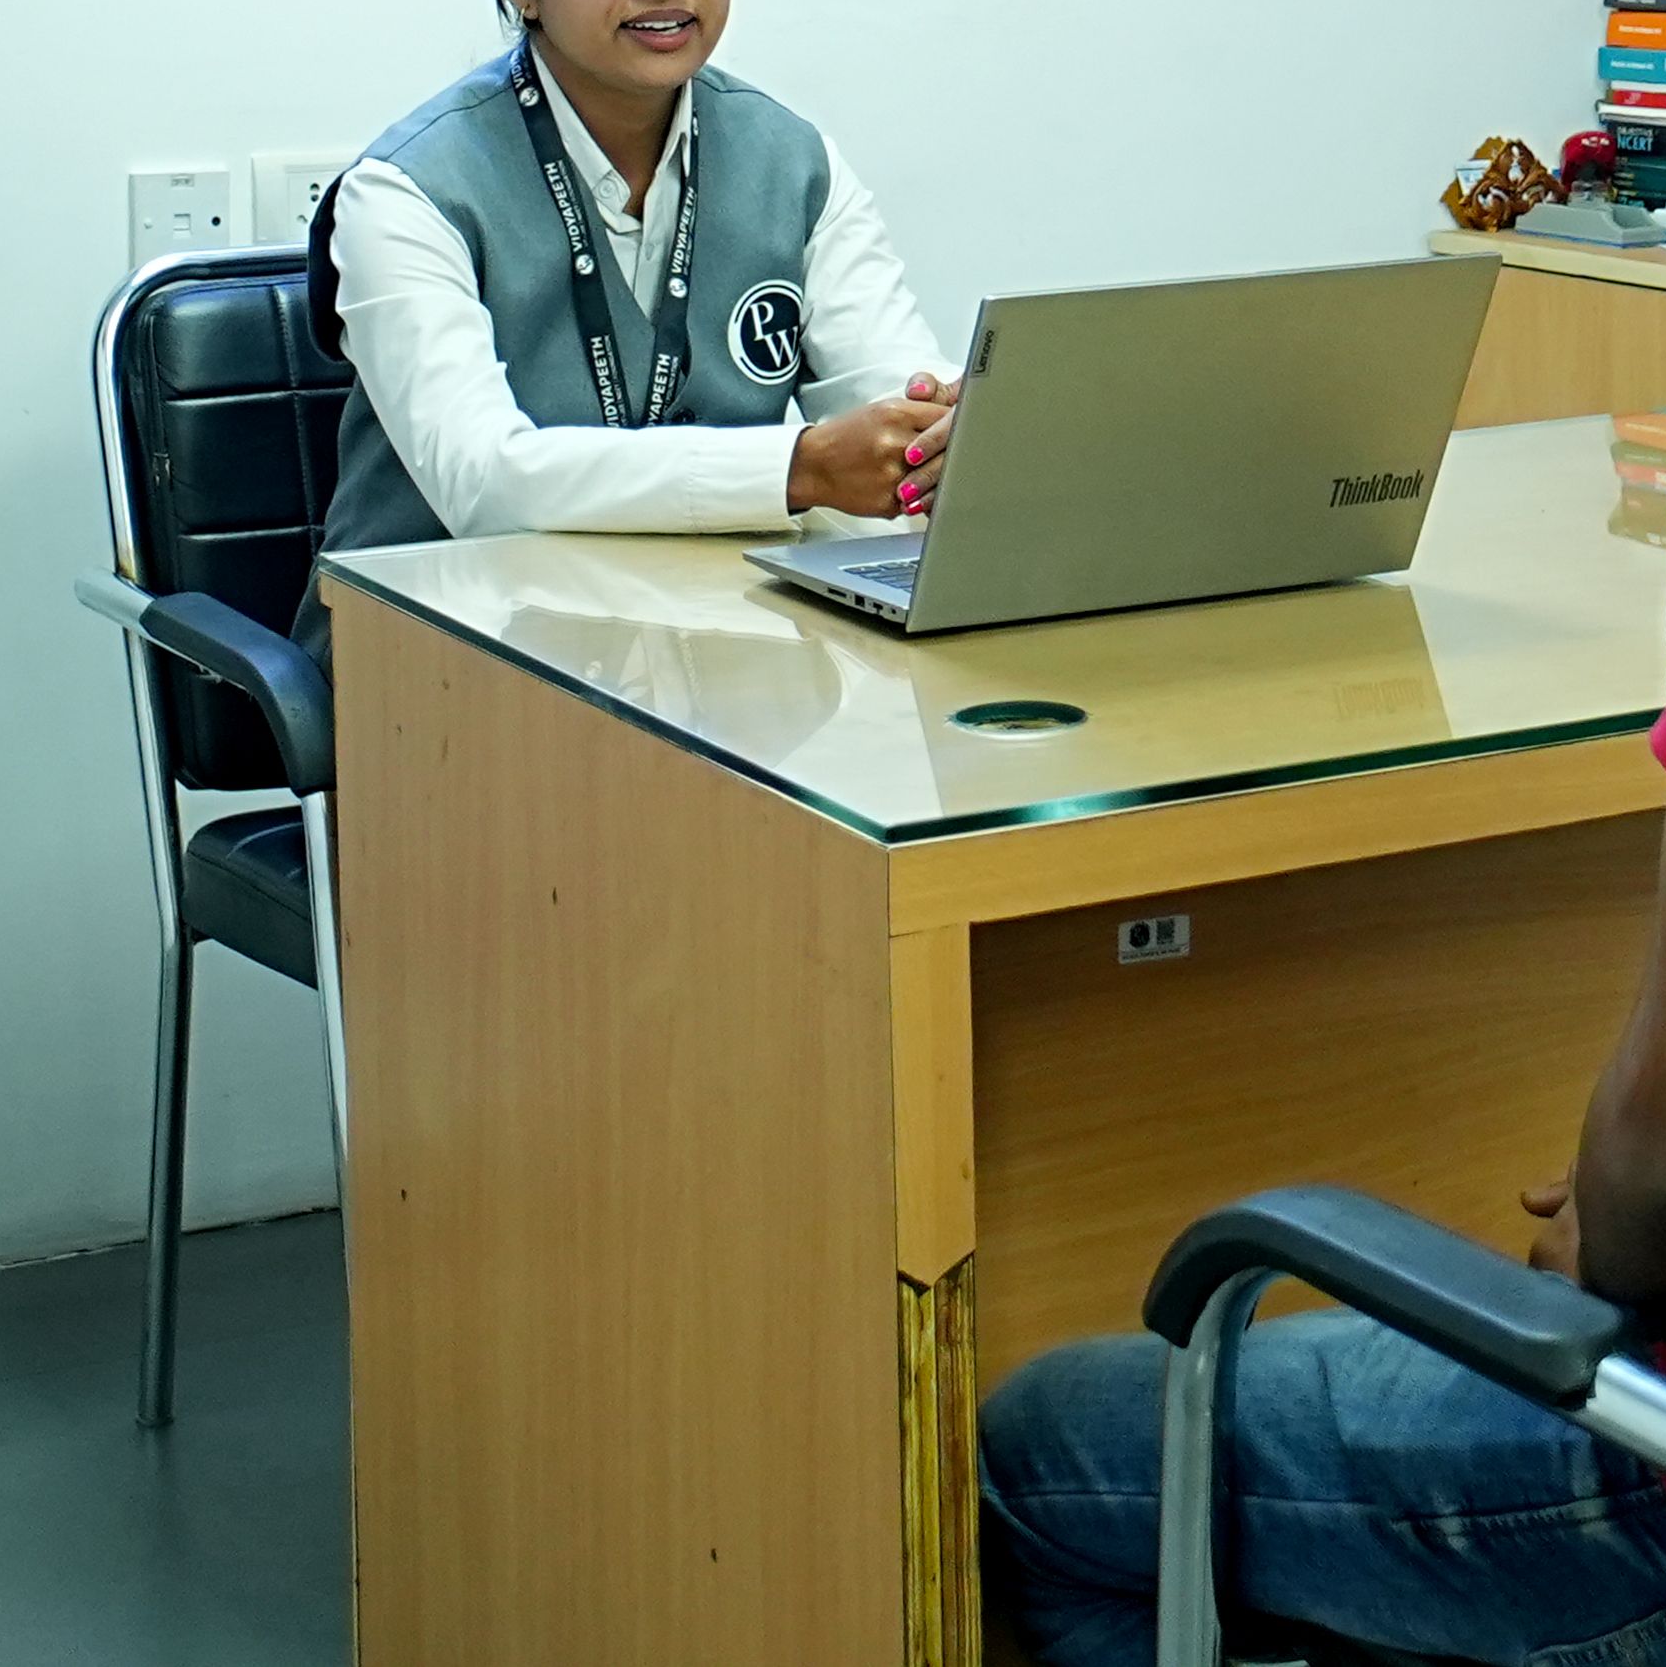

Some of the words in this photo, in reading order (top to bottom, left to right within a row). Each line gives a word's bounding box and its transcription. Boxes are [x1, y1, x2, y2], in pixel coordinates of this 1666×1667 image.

[1617, 136, 1653, 151] NCERT
[544, 161, 583, 253] VIDYAPEETH
[671, 186, 695, 274] VIDYAPEETH
[976, 328, 995, 373] Lenovo
[1329, 469, 1425, 508] ThinkBook
